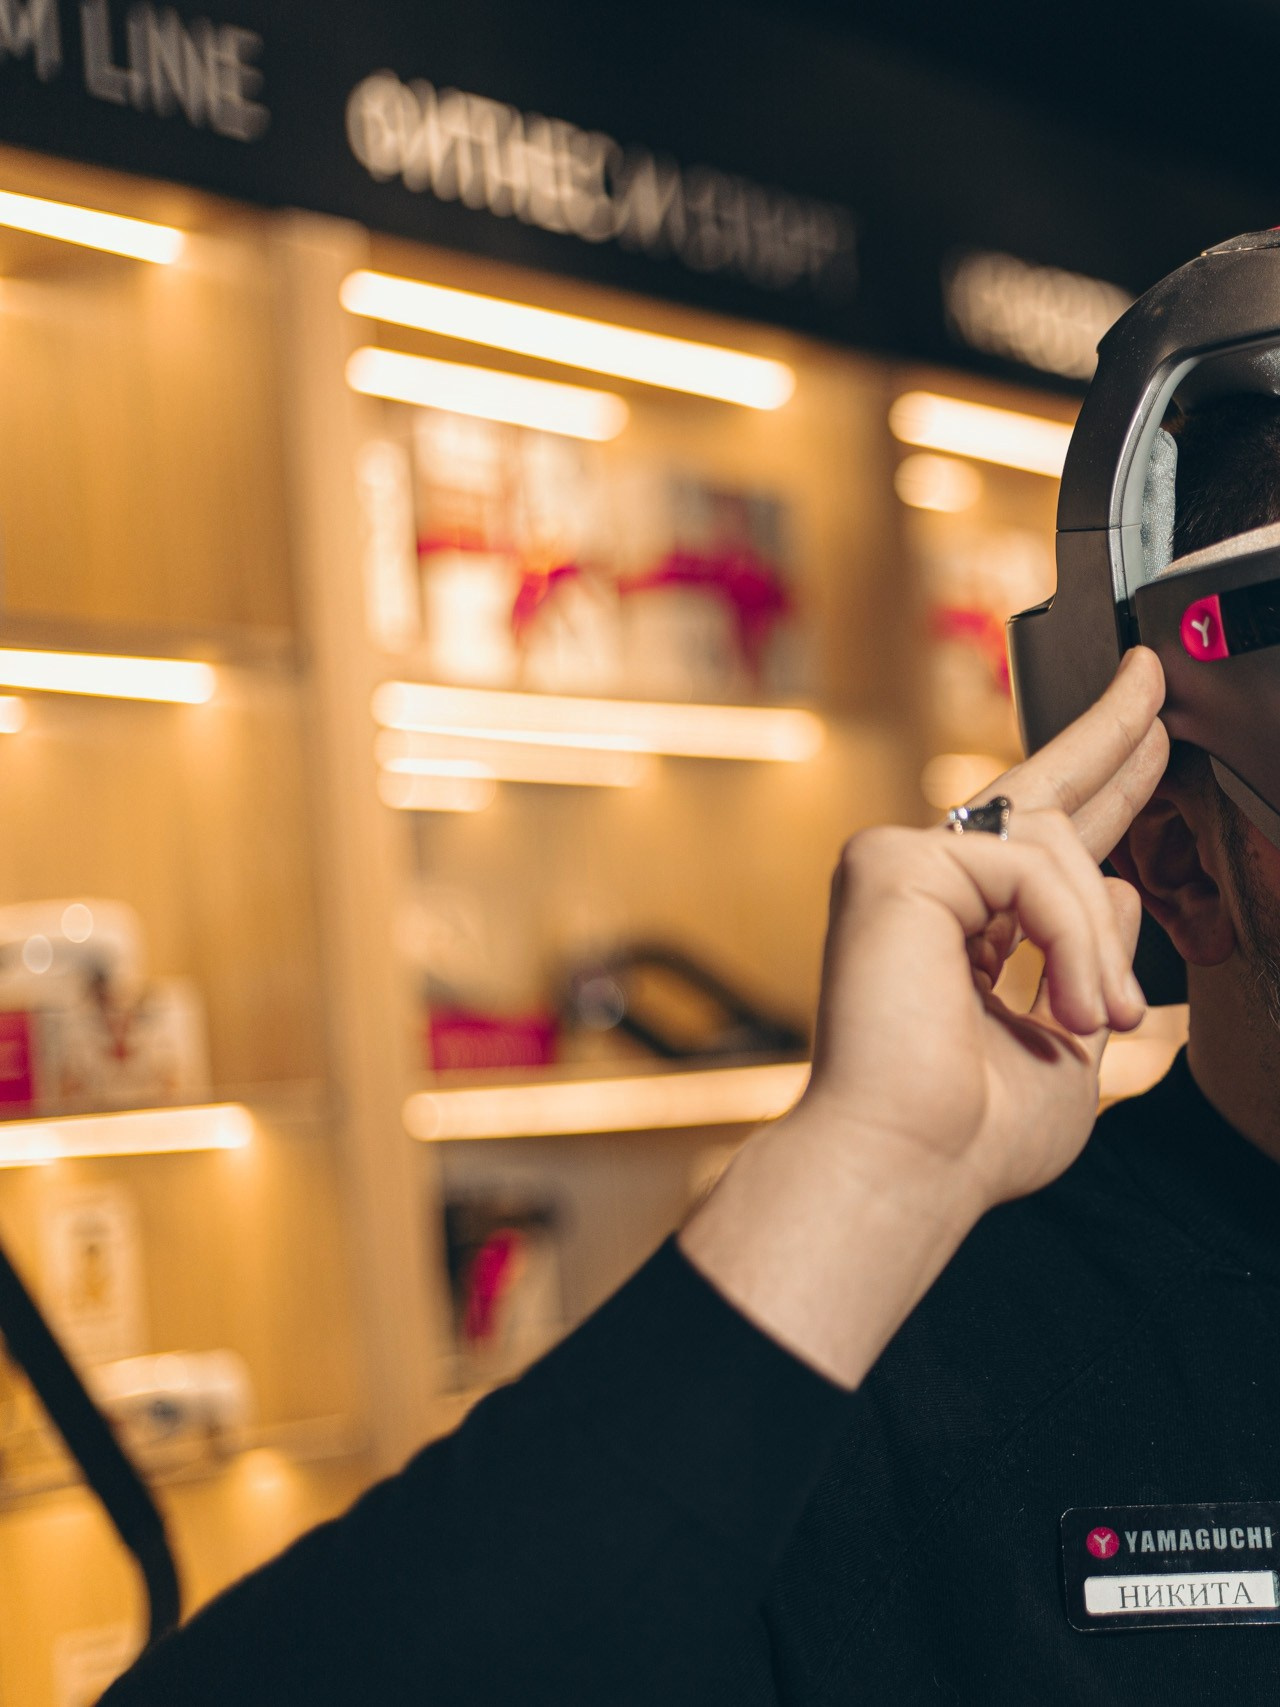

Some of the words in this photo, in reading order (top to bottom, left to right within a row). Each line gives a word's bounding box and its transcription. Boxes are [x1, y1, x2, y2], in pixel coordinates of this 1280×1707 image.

[81, 0, 270, 142] LINE
[1124, 1526, 1273, 1553] YAMAGUCHI
[1118, 1582, 1254, 1609] НИКИТА
